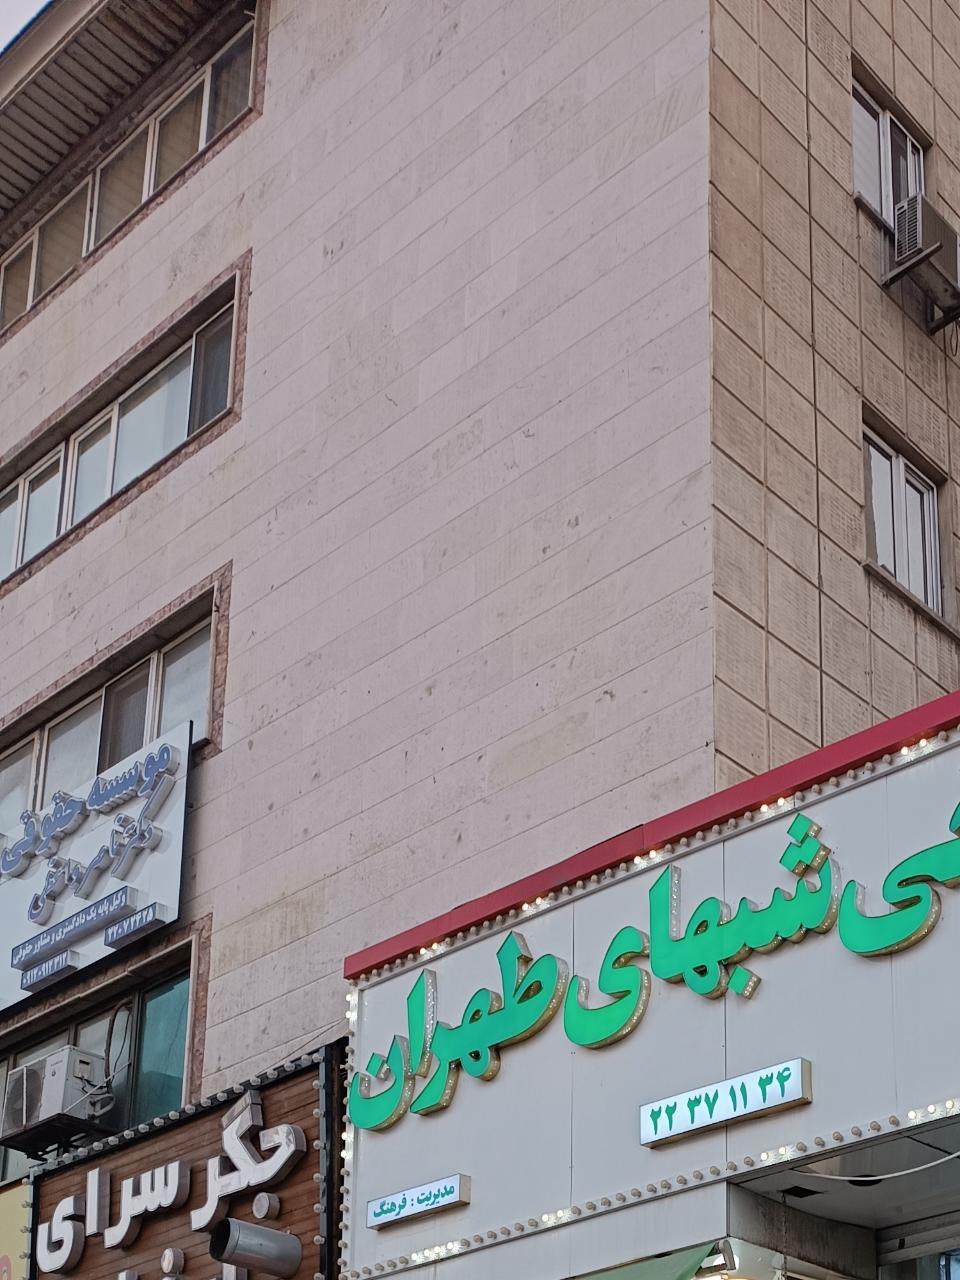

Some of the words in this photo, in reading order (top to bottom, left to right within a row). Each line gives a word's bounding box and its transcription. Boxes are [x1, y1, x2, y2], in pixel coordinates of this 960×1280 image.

[1, 790, 86, 874] حقوقی
[564, 812, 840, 1048] شبهای
[349, 931, 566, 1130] طهران
[37, 1160, 182, 1273] سرای
[191, 1091, 303, 1231] جگر
[373, 1193, 407, 1217] فرهنگ
[417, 1184, 455, 1206] مدیریت
